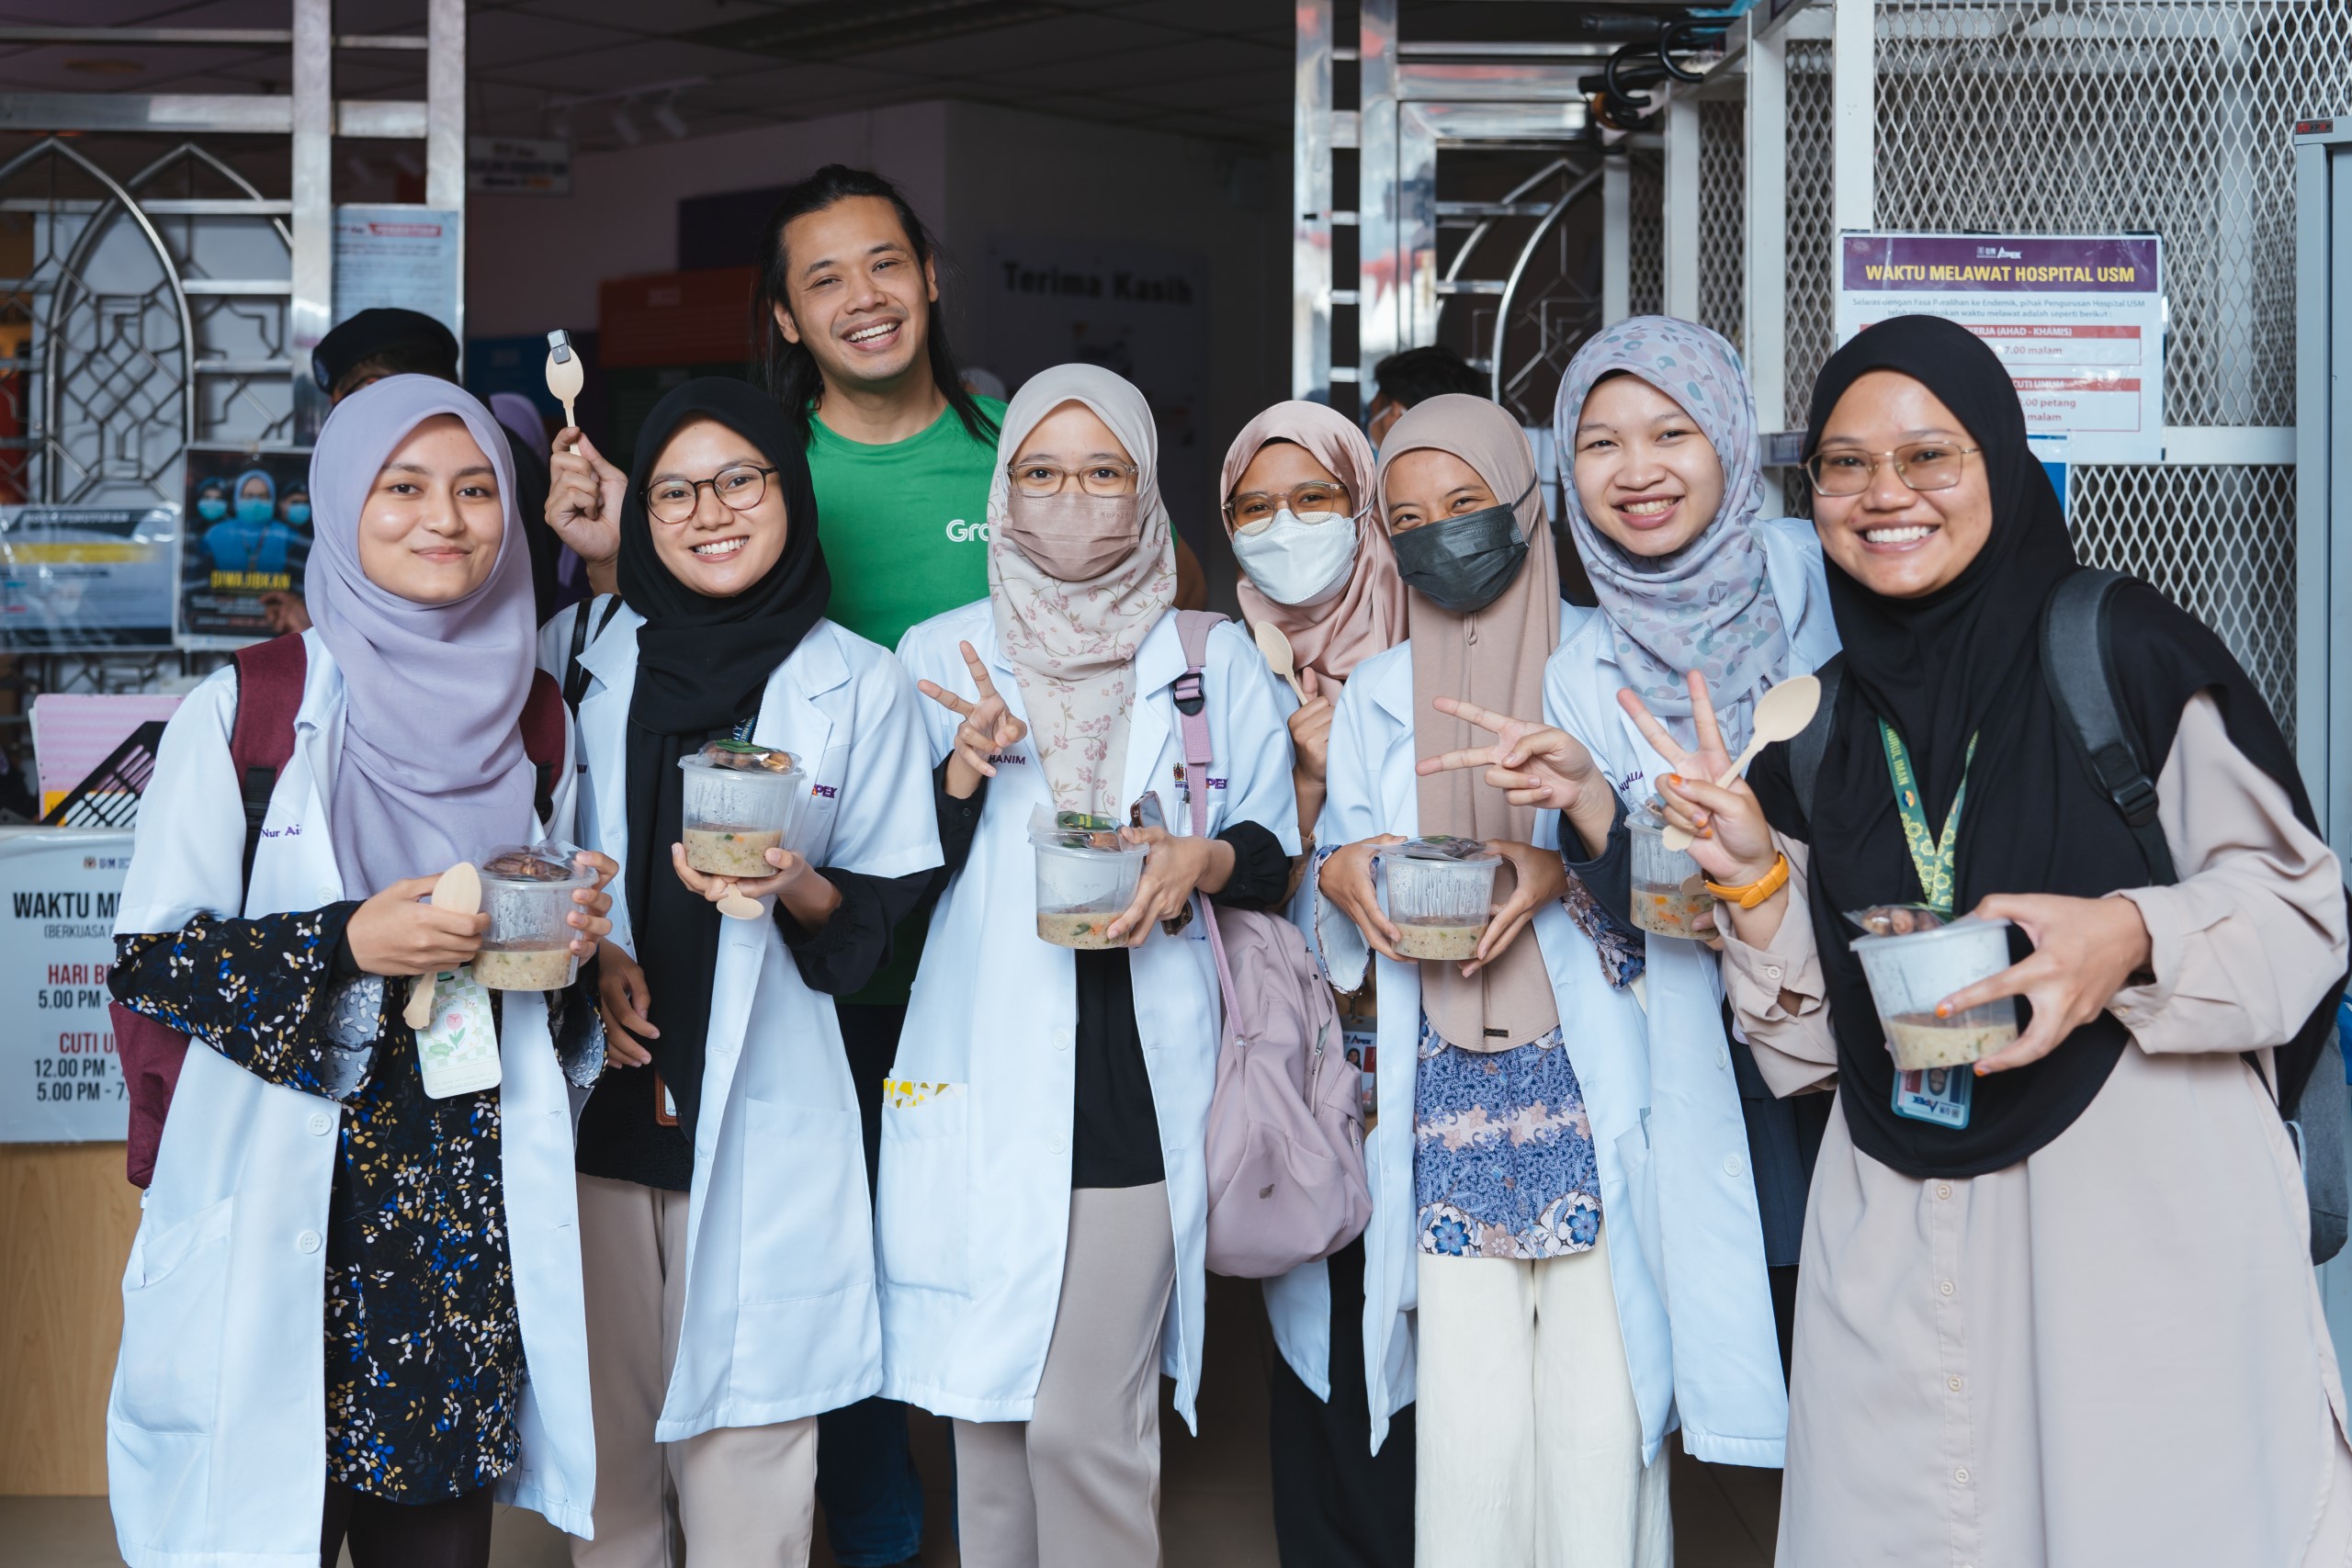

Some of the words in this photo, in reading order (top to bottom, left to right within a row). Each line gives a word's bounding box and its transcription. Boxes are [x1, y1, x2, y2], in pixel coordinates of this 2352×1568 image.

[1865, 265, 1926, 281] WAKTU
[1929, 265, 2012, 282] MELAWAT
[2015, 266, 2094, 283] HOSPITAL
[2098, 266, 2135, 283] USM
[1002, 260, 1102, 299] Terima
[1113, 270, 1193, 305] Kasih
[1852, 298, 1881, 306] Selaras
[1983, 299, 2017, 308] Endemik,
[2019, 299, 2041, 309] pihak
[2043, 300, 2091, 309] Pengurusan
[2093, 299, 2125, 309] Hospital
[2050, 310, 2078, 319] seperti
[1996, 327, 2028, 336] (AHAD
[2033, 328, 2073, 337] KHAMIS)
[2005, 346, 2026, 355] 7.00
[2028, 345, 2063, 355] malam
[2041, 399, 2076, 410] petang
[2028, 412, 2062, 422] malam
[987, 754, 1026, 765] HANIM
[1893, 758, 1910, 786] IMAN
[261, 829, 280, 838] Nur
[13, 892, 90, 919] WAKTU
[44, 924, 106, 939] (BERKUASA
[48, 964, 88, 986] HARI
[39, 989, 74, 1009] 5.00
[78, 989, 100, 1009] PM
[60, 1032, 97, 1054] CUTI
[104, 1032, 119, 1054] U
[34, 1058, 78, 1077] 12.00
[83, 1058, 105, 1077] PM
[37, 1082, 73, 1101] 5.00
[77, 1082, 100, 1101] PM
